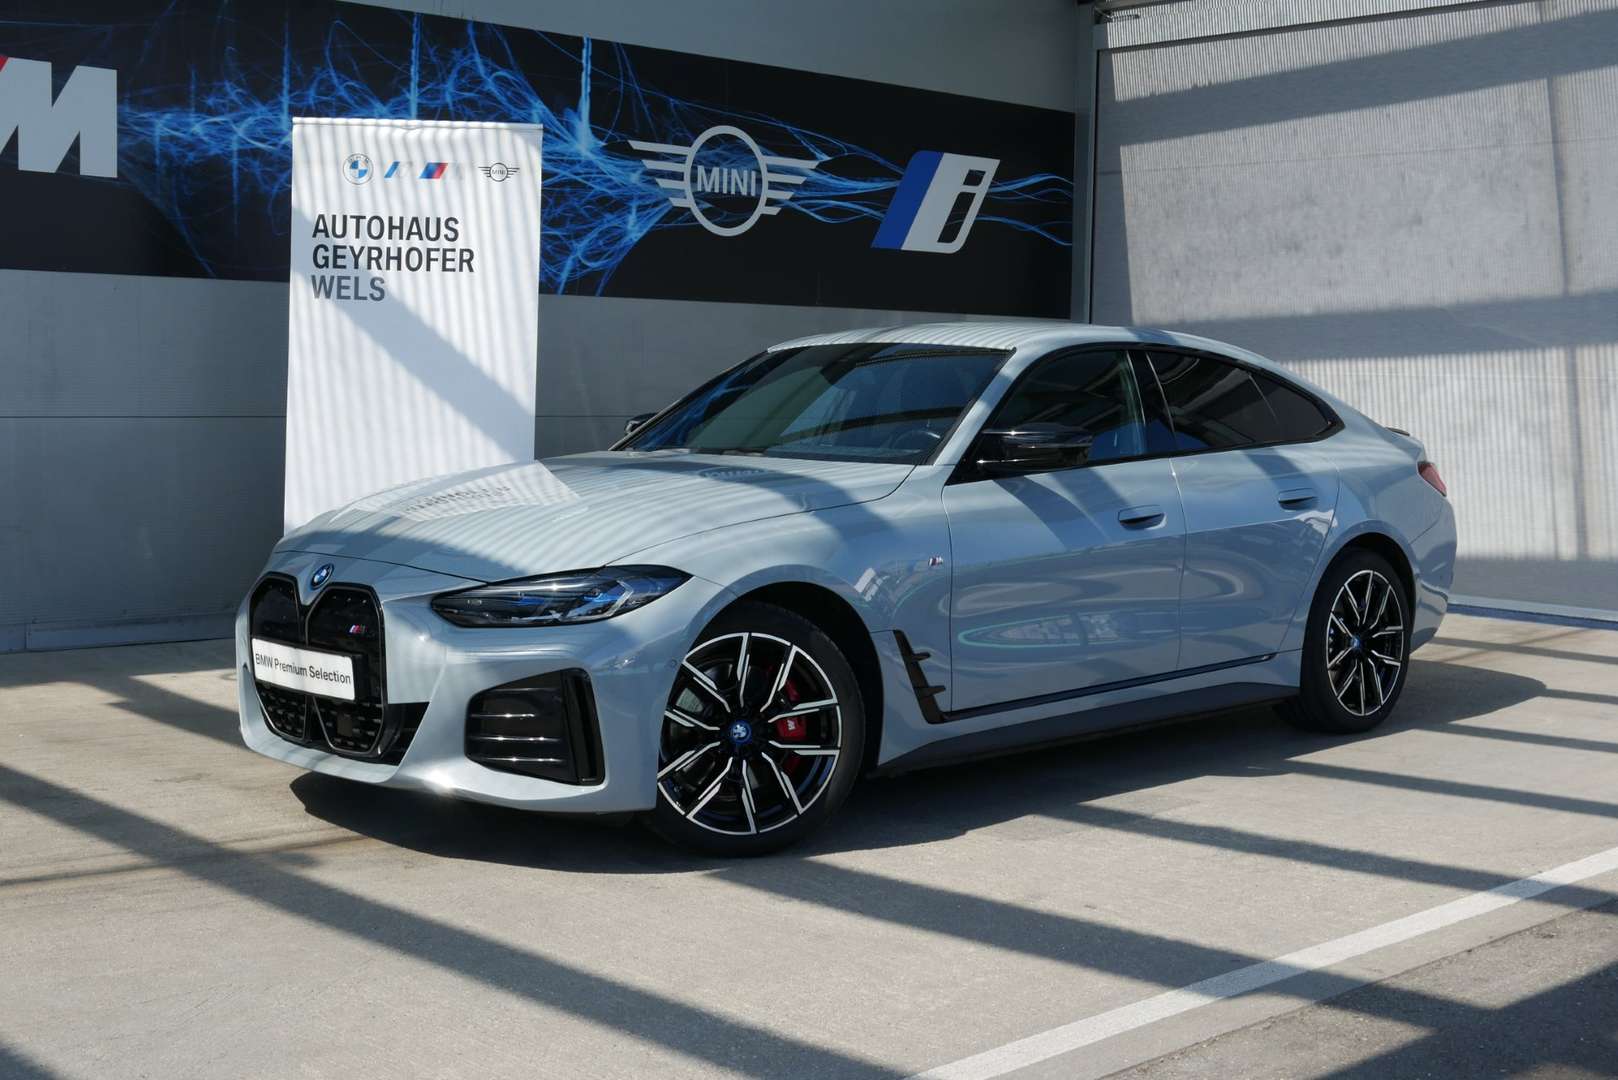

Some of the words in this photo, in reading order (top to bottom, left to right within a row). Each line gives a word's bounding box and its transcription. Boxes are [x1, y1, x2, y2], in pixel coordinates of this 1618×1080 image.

[0, 56, 118, 178] M
[696, 165, 757, 197] MINI
[312, 214, 460, 242] AUTOHAUS
[312, 244, 475, 272] GEYRHOFER
[311, 274, 385, 301] WELS
[255, 653, 273, 669] BMW
[274, 658, 308, 677] Premium
[308, 665, 352, 685] Selection
